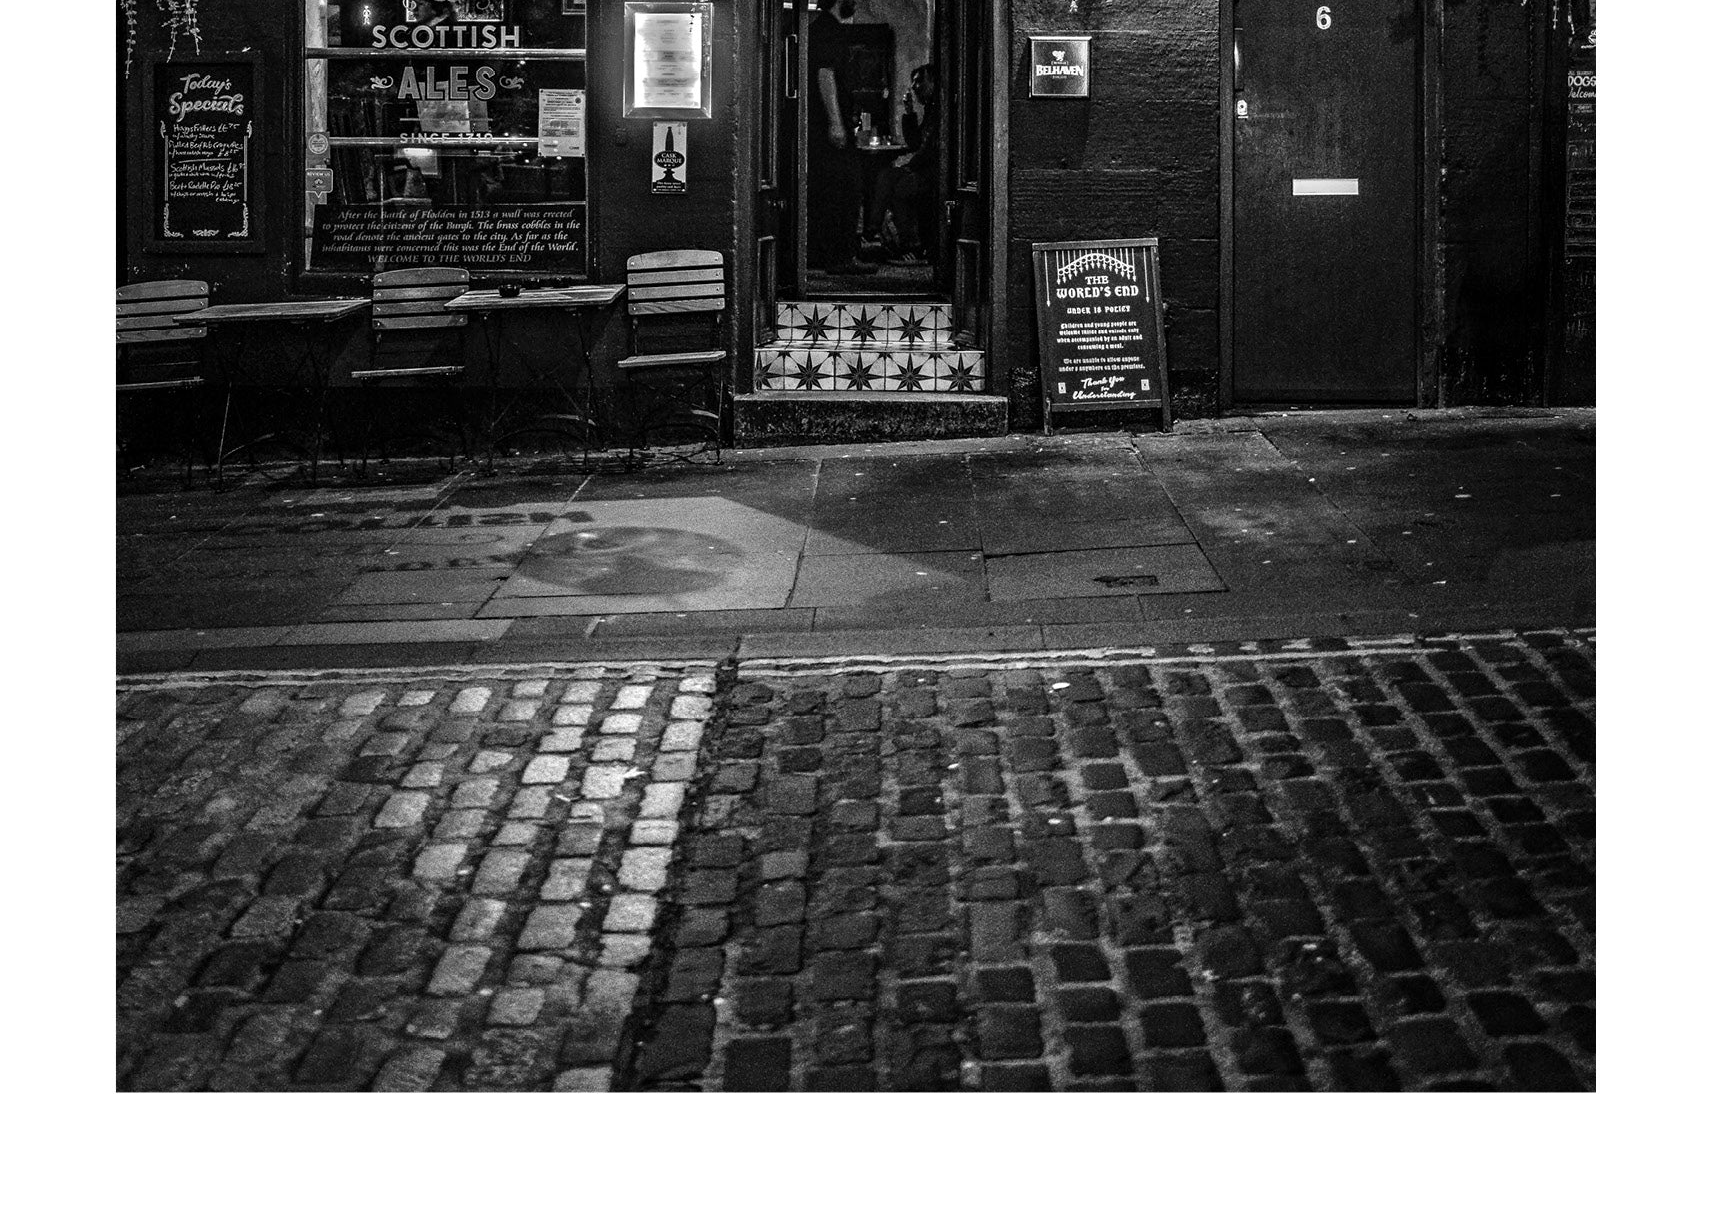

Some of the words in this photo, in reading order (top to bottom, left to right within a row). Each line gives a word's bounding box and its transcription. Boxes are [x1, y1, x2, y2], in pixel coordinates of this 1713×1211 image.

[1316, 6, 1331, 30] 6
[372, 25, 520, 48] SCOTTISH
[1036, 64, 1084, 77] BELHAVEN
[180, 73, 232, 95] Today's
[397, 66, 497, 100] ALES
[1568, 75, 1596, 87] DOGS
[169, 92, 244, 122] Specials
[400, 133, 449, 144] SINCE
[338, 210, 360, 223] After
[364, 211, 378, 219] the
[381, 210, 407, 219] Battle
[409, 210, 421, 223] of
[421, 209, 455, 219] Flodden
[459, 210, 467, 218] in
[470, 210, 490, 219] 1513
[501, 209, 521, 218] wall
[543, 209, 575, 218] erected
[322, 222, 331, 230] to
[330, 223, 365, 233] protect
[367, 221, 381, 230] the
[383, 222, 416, 230] citizens
[417, 220, 429, 233] of
[430, 220, 443, 230] the
[446, 220, 474, 233] Burgh.
[477, 220, 494, 230] The
[496, 220, 519, 230] brass
[521, 219, 551, 230] cobbles
[554, 220, 563, 229] in
[566, 219, 581, 229] the
[333, 231, 355, 241] road
[355, 231, 384, 241] denote
[387, 231, 401, 240] the
[403, 231, 434, 240] ancient
[437, 233, 459, 244] gates
[474, 231, 487, 240] the
[511, 232, 523, 240] As
[521, 230, 539, 243] far
[554, 230, 568, 240] the
[322, 243, 371, 252] inhabitants
[396, 242, 440, 251] concerned
[443, 242, 459, 251] this
[482, 242, 496, 251] the
[499, 241, 518, 251] End
[518, 242, 530, 253] of
[531, 242, 545, 251] the
[547, 241, 579, 251] World.
[367, 254, 419, 263] WELCOME
[422, 254, 435, 263] TO
[439, 254, 460, 263] THE
[463, 254, 507, 263] WORLD'S
[509, 253, 532, 263] END
[1085, 276, 1109, 285] THE
[1056, 286, 1112, 299] WORLD'S
[1114, 285, 1139, 297] END
[1094, 306, 1102, 314] 18
[1104, 305, 1131, 313] POLICY
[1094, 321, 1110, 329] young
[1081, 376, 1108, 389] Thank
[1108, 376, 1125, 388] You
[1072, 390, 1137, 400] Understanding
